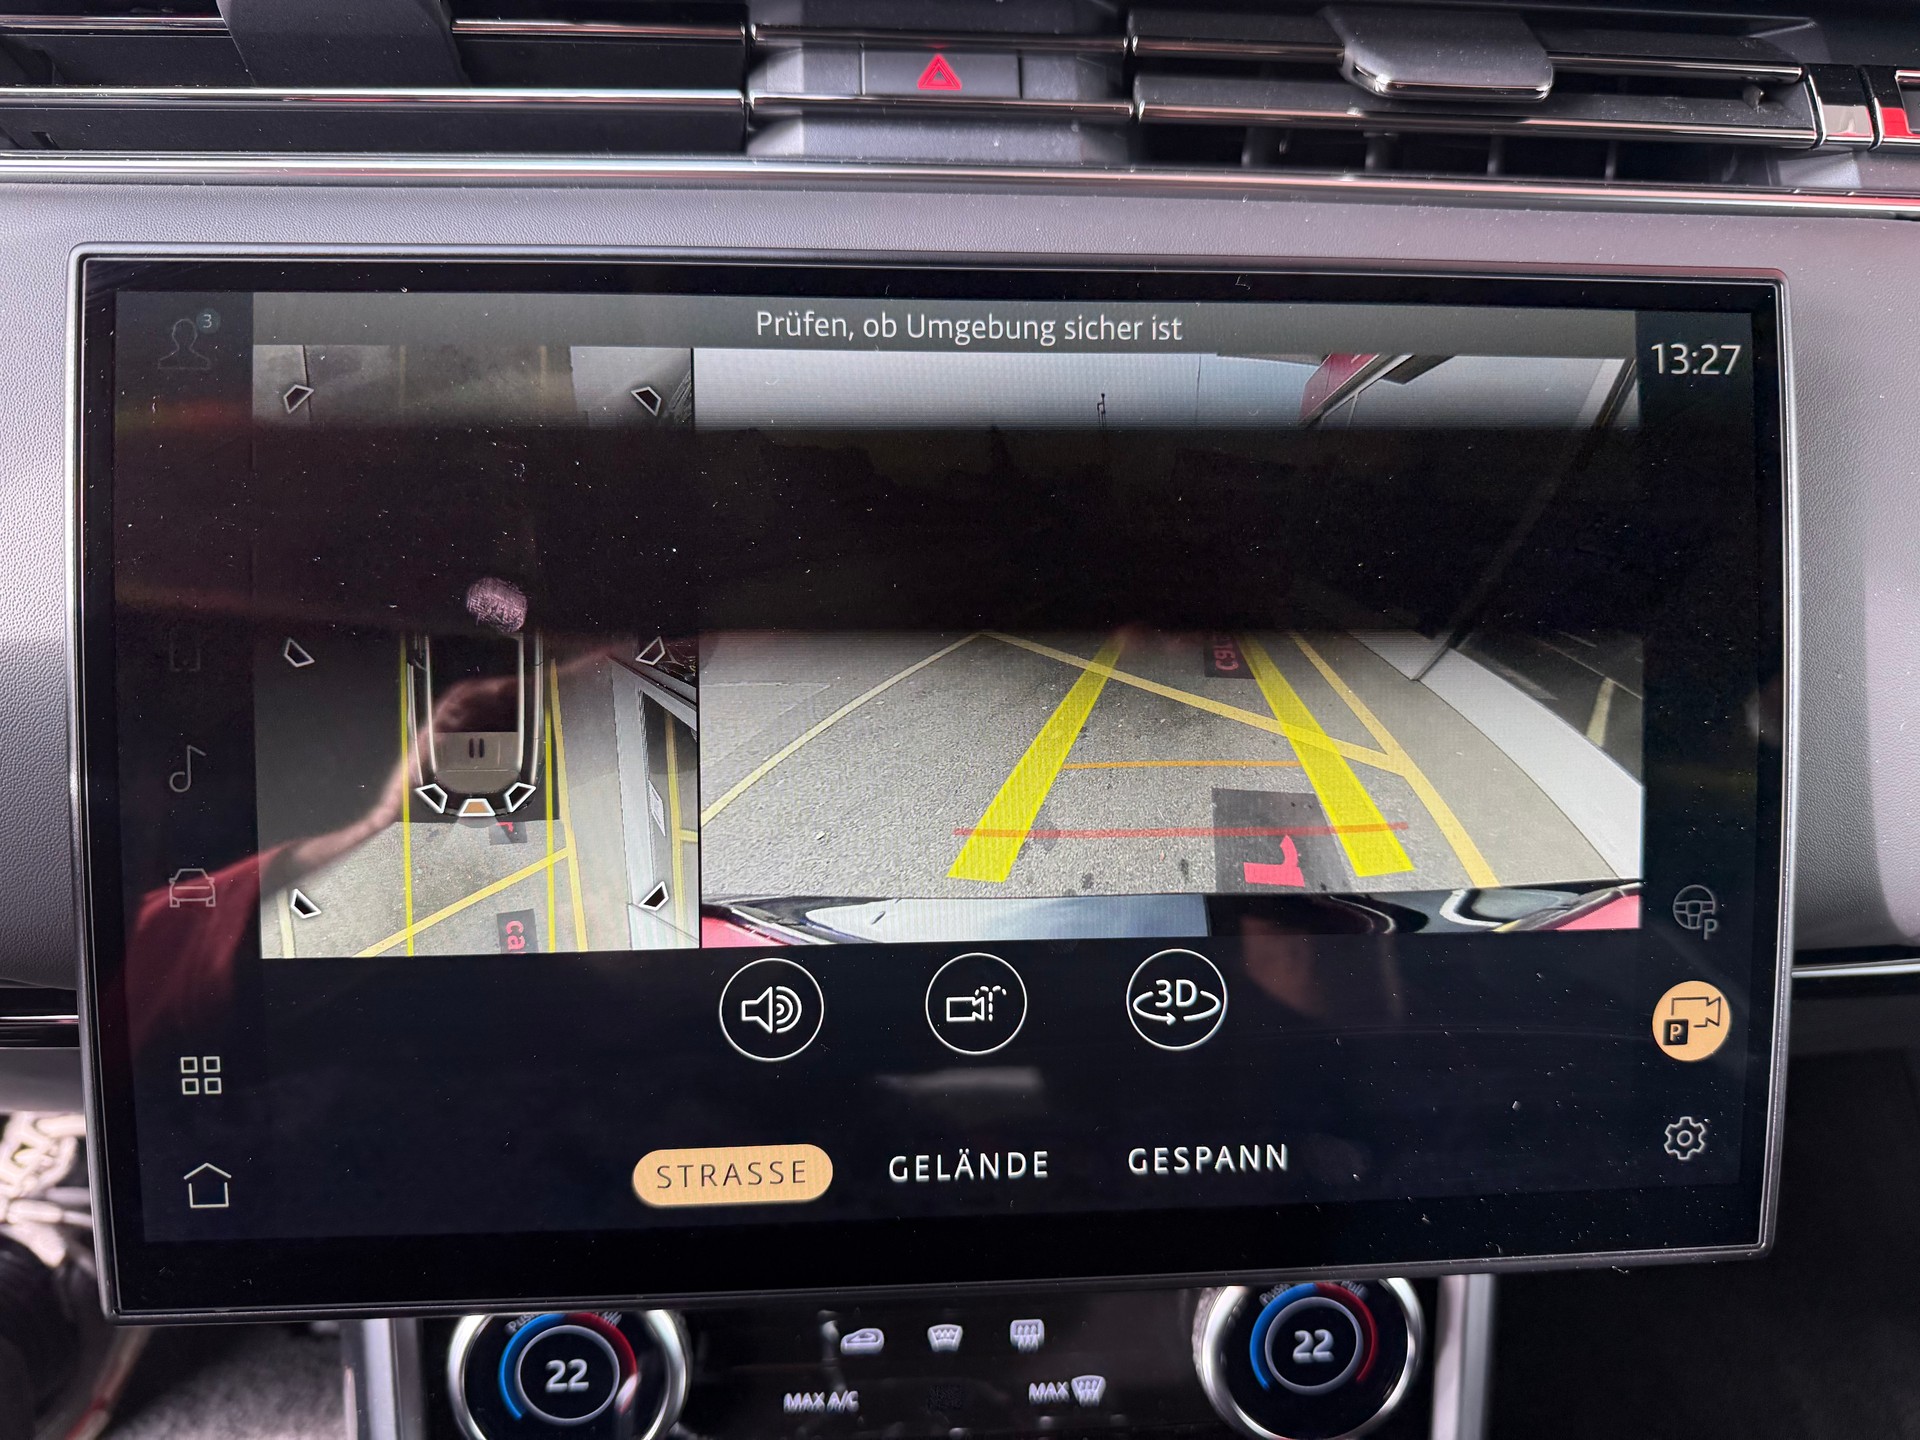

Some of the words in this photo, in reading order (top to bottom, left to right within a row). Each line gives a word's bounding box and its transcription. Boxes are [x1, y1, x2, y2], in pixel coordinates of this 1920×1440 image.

[202, 313, 212, 328] 3
[755, 309, 855, 343] Prüfen,
[863, 311, 897, 339] ob
[906, 312, 1056, 347] Umgebung
[1064, 314, 1143, 341] sicher
[1151, 315, 1184, 341] ist
[1650, 342, 1742, 375] 13:27
[1155, 979, 1198, 1008] 3D
[655, 1158, 808, 1190] STRASSE
[887, 1148, 1050, 1183] GELÄNDE
[1127, 1142, 1289, 1175] GESPANN
[1292, 1328, 1336, 1364] 22
[545, 1358, 590, 1393] 22
[1028, 1380, 1070, 1404] MAX
[783, 1391, 825, 1413] MAX
[827, 1389, 860, 1413] A/C
